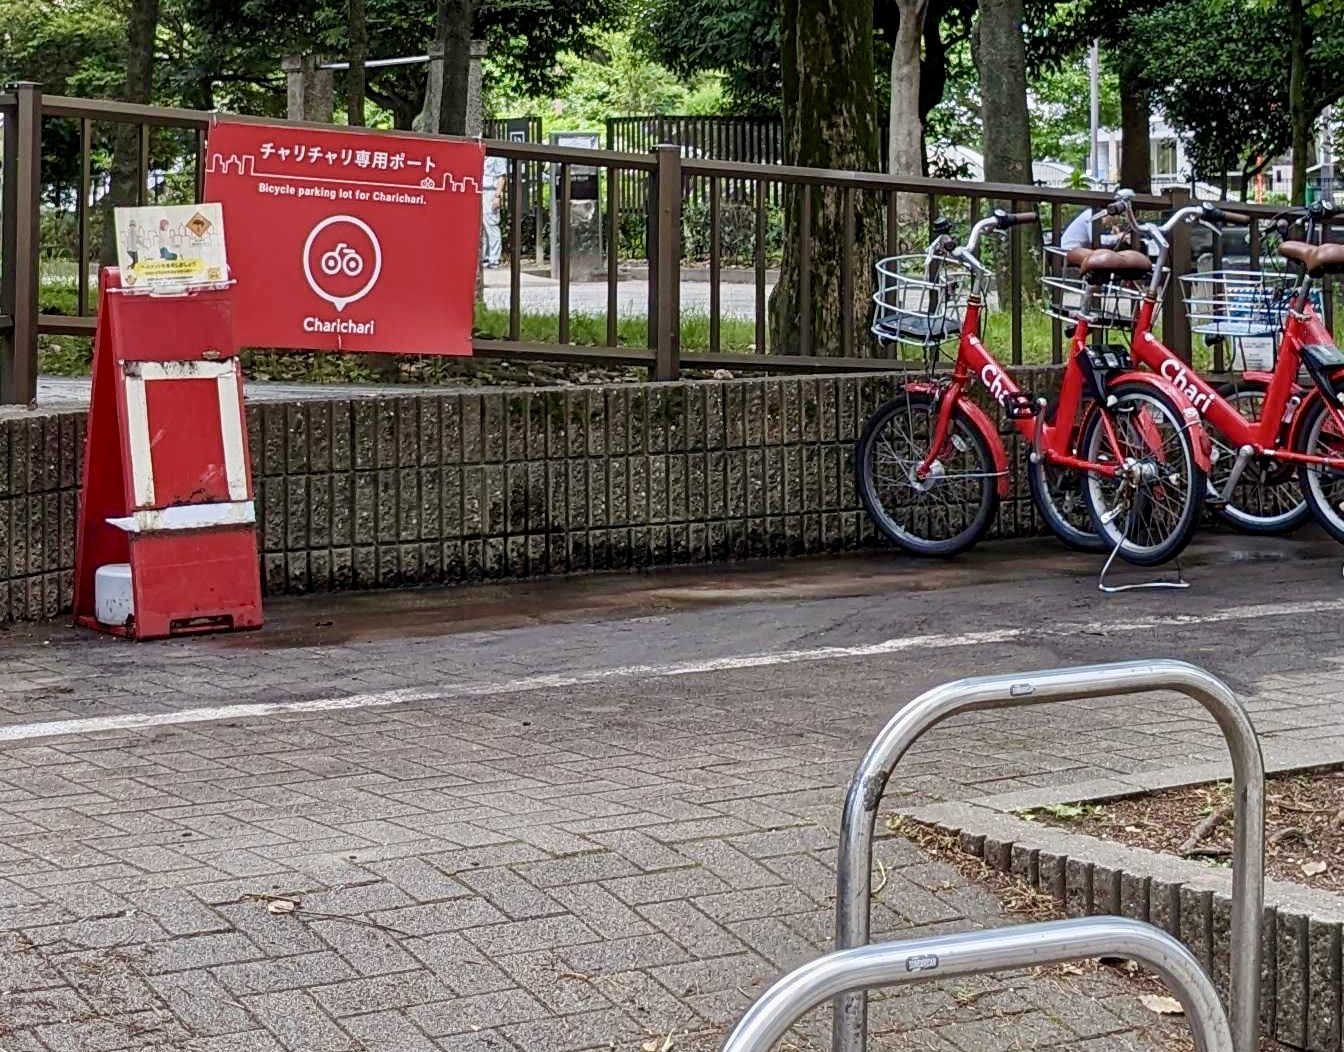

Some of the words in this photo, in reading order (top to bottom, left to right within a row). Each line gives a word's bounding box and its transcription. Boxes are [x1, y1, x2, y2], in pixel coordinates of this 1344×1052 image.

[258, 182, 296, 197] Bicycle
[298, 186, 337, 200] parking
[339, 188, 353, 200] lot
[355, 189, 370, 201] for
[372, 191, 427, 206] Charichari.
[302, 317, 375, 335] Charichari
[1160, 359, 1216, 414] Chari
